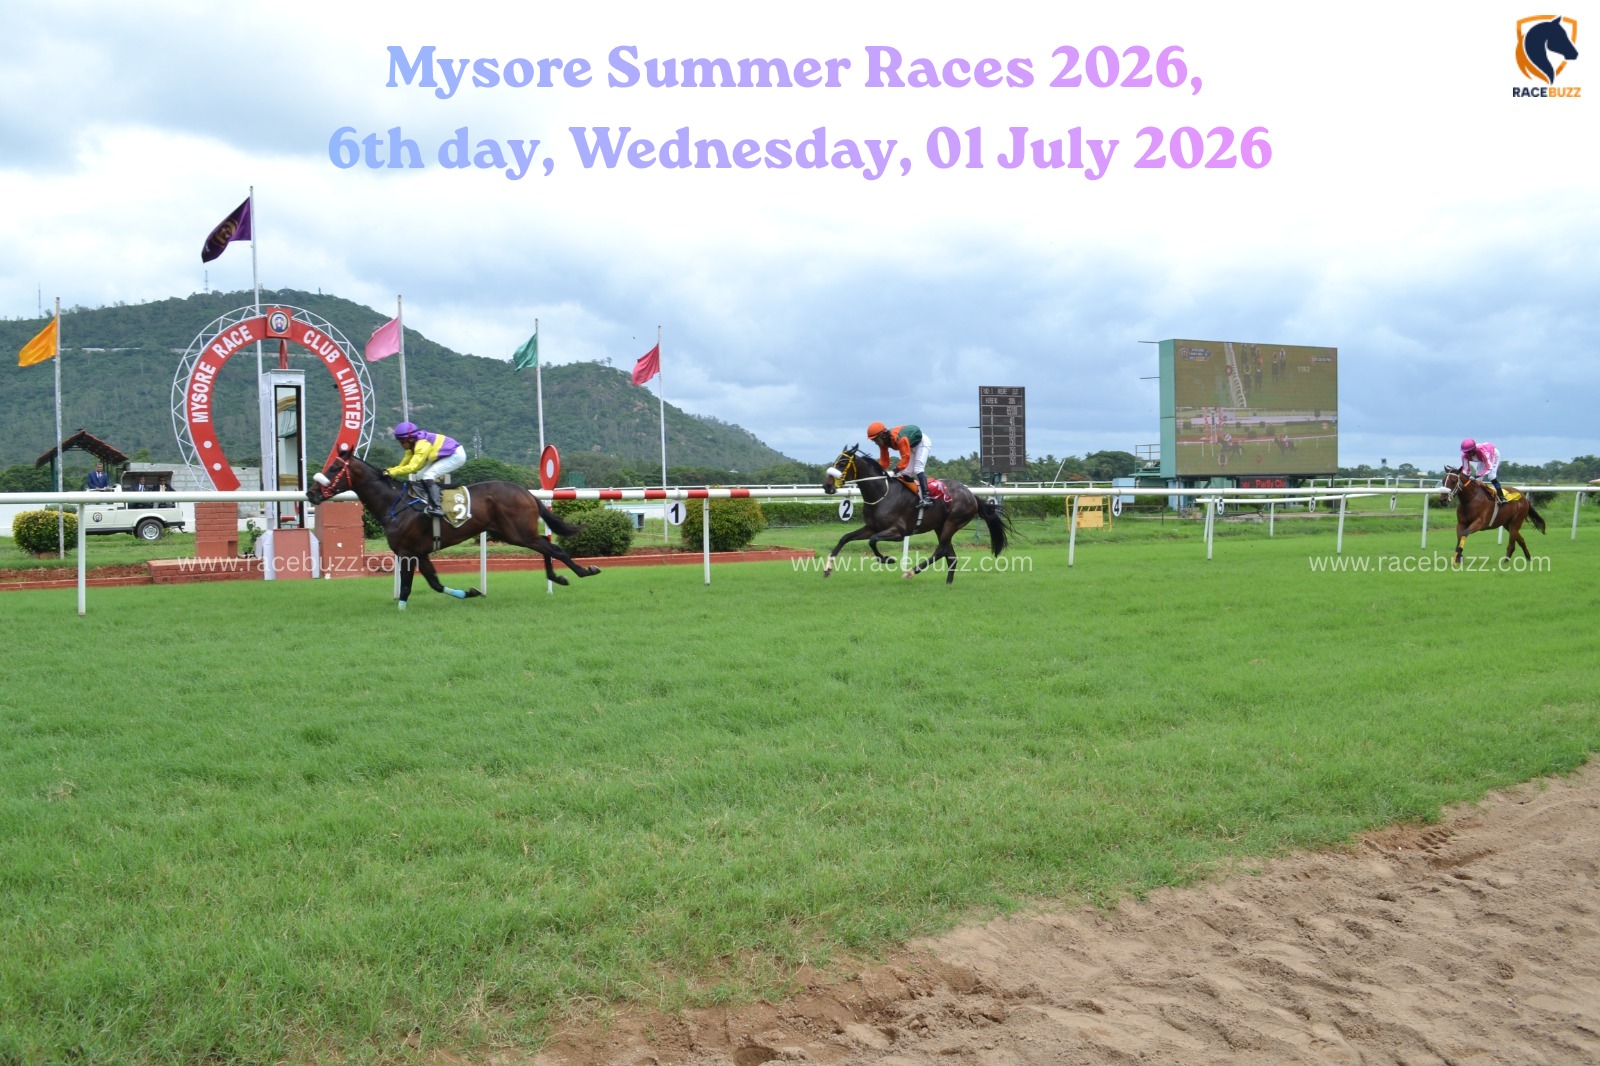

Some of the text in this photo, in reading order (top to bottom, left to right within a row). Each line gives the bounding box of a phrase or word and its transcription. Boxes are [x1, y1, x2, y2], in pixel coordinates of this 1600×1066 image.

[191, 325, 361, 430] MYSORE RACE CLUB LIMITED
[670, 502, 679, 524] 1
[842, 499, 851, 519] 2
[1113, 498, 1120, 515] 4
